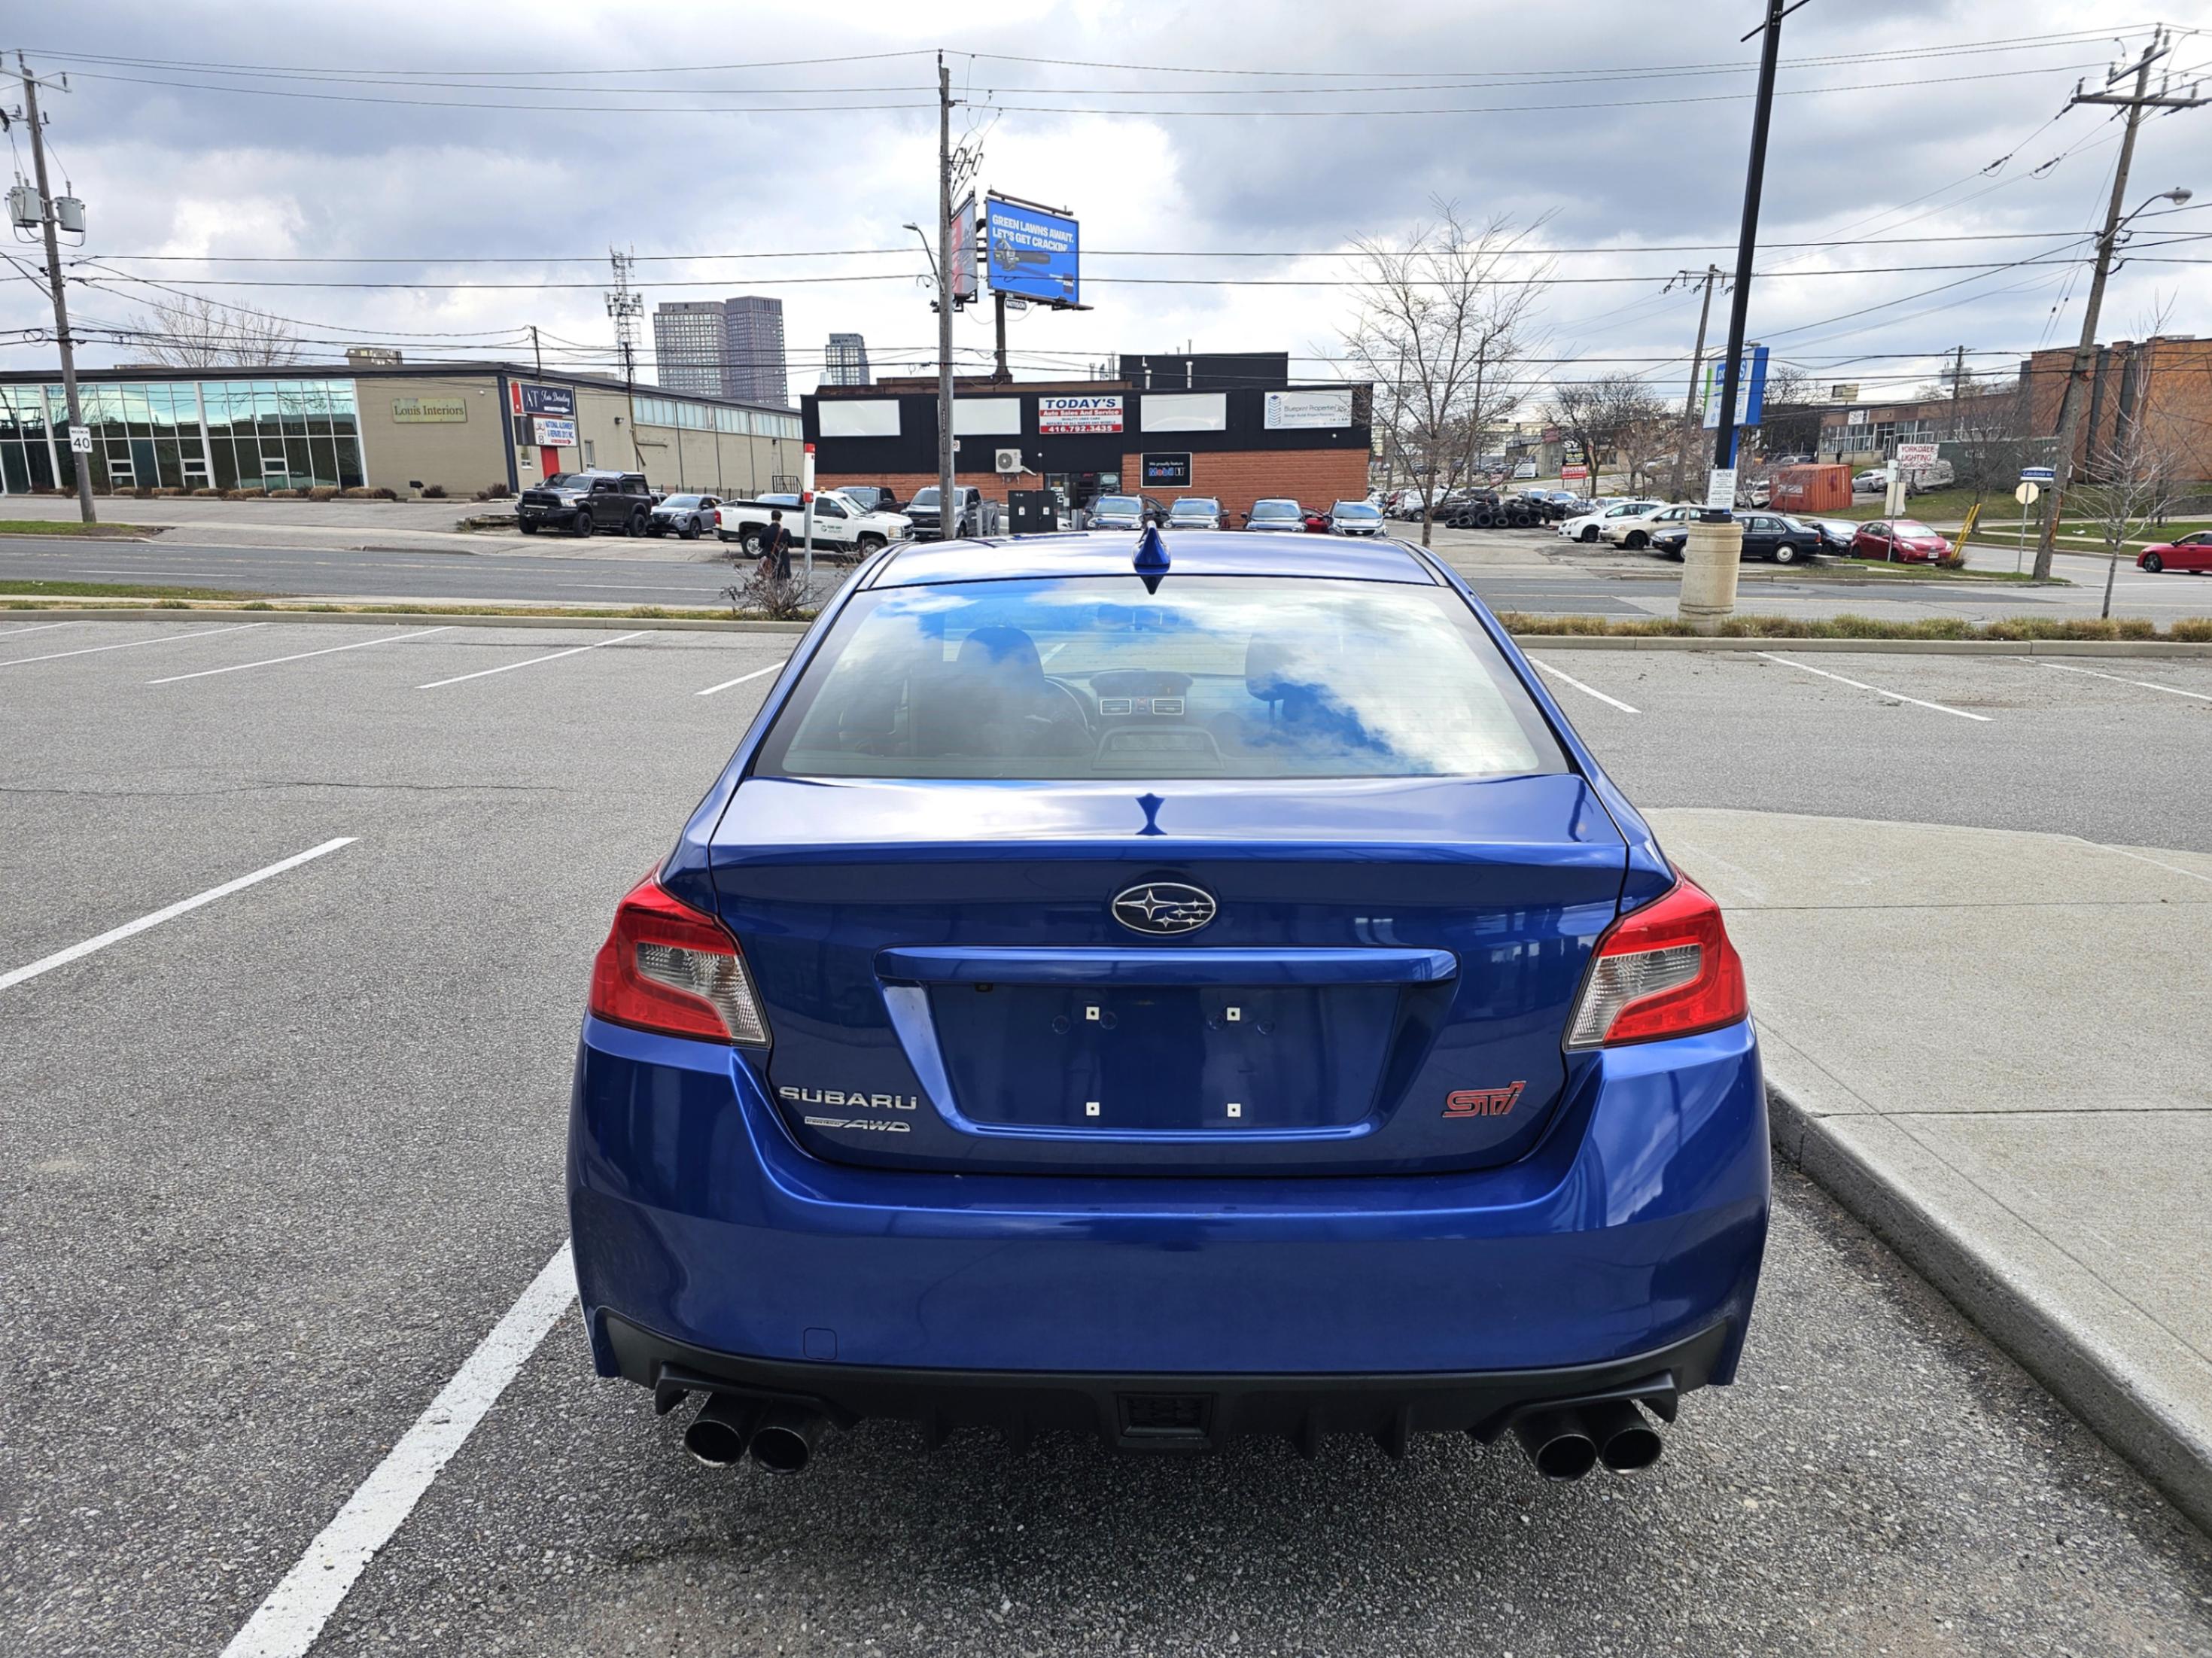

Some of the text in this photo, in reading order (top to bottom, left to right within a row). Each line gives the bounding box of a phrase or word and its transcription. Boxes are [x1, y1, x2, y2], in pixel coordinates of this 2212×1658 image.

[992, 214, 1074, 244] GREEN LAWNS AWAIT.
[992, 227, 1015, 242] LET'S
[1015, 233, 1032, 245] GET
[527, 390, 539, 407] AT
[1045, 398, 1116, 409] TODAY'S
[394, 405, 464, 415] Louis Interiors
[545, 421, 559, 429] NATIONAL
[1048, 424, 1113, 433] 416.792.3435
[73, 437, 90, 449] 40
[1149, 467, 1174, 476] Mobil
[778, 1085, 917, 1110] SUBARU
[843, 1119, 911, 1133] AWD
